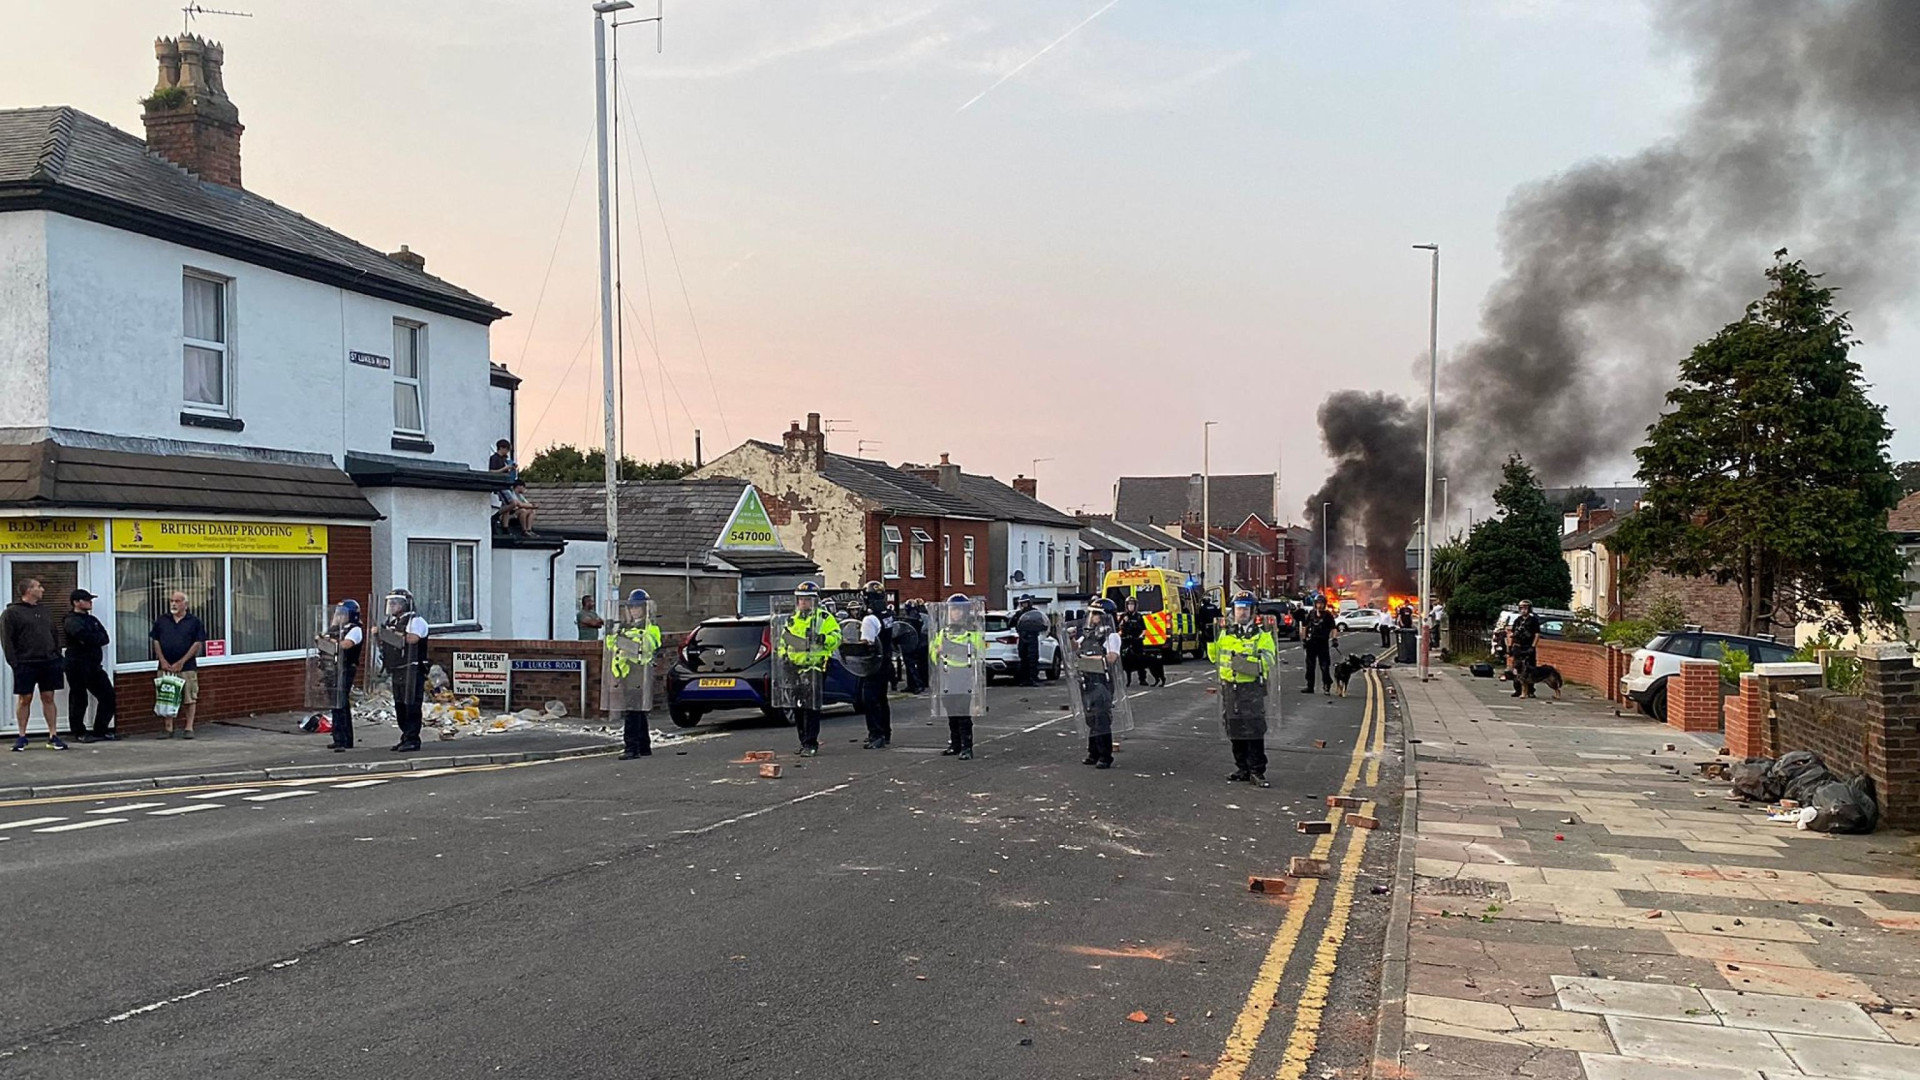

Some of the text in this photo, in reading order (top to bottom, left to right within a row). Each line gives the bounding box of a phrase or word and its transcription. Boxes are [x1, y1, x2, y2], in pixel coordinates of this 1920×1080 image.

[358, 354, 375, 364] LUKES
[53, 521, 77, 532] Ltd
[161, 523, 292, 537] BRITISH DAMP PROOFING
[731, 531, 772, 541] 547000
[457, 653, 506, 661] REPLACEMENT
[483, 661, 499, 669] TIES
[515, 661, 577, 669] ST LUKES ROAD
